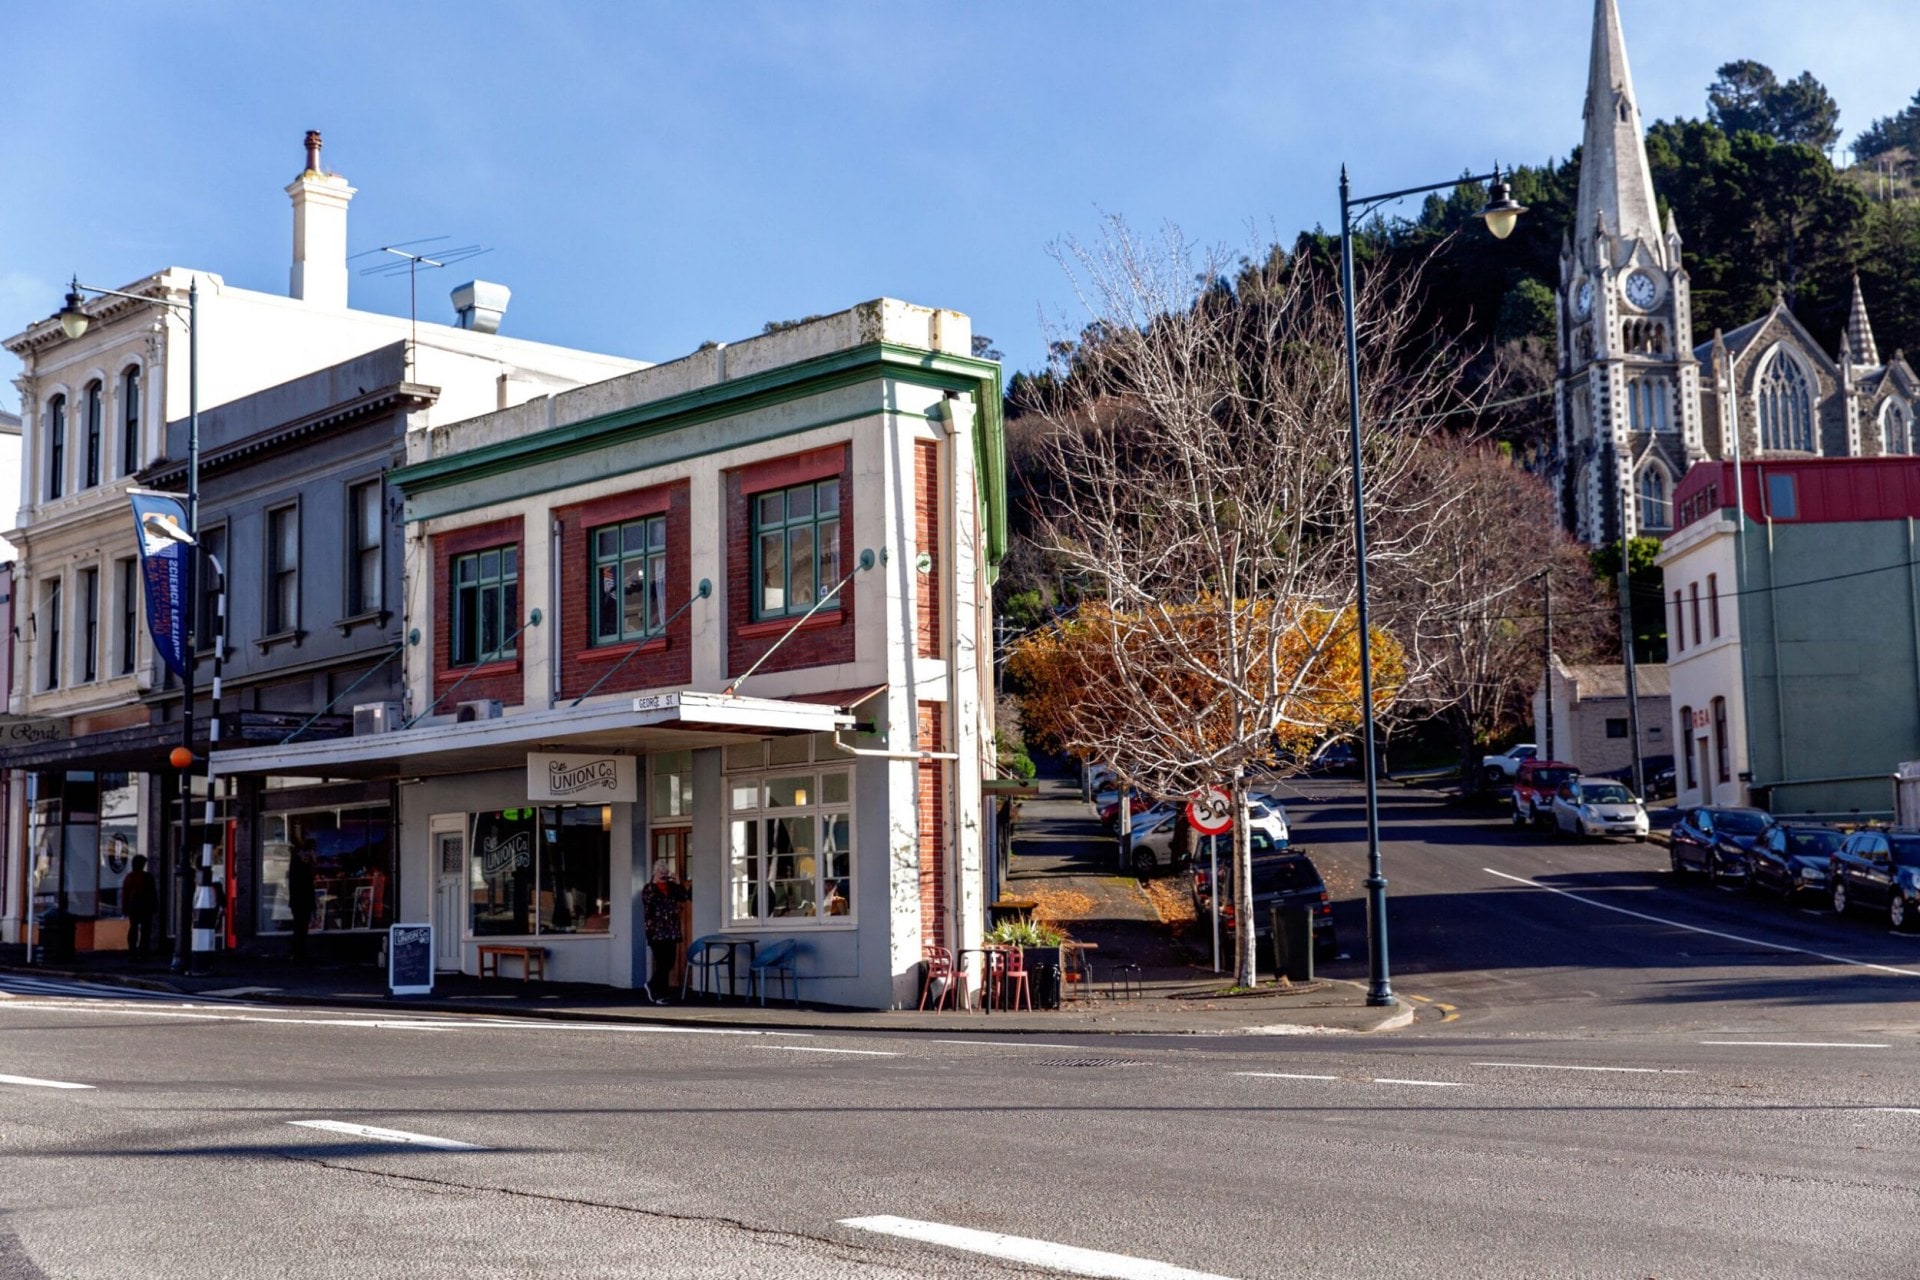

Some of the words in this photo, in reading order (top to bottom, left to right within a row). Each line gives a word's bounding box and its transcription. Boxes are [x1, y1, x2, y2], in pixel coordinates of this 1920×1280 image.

[1692, 709, 1710, 728] RSA
[552, 766, 595, 790] UNION
[487, 839, 515, 869] UNION
